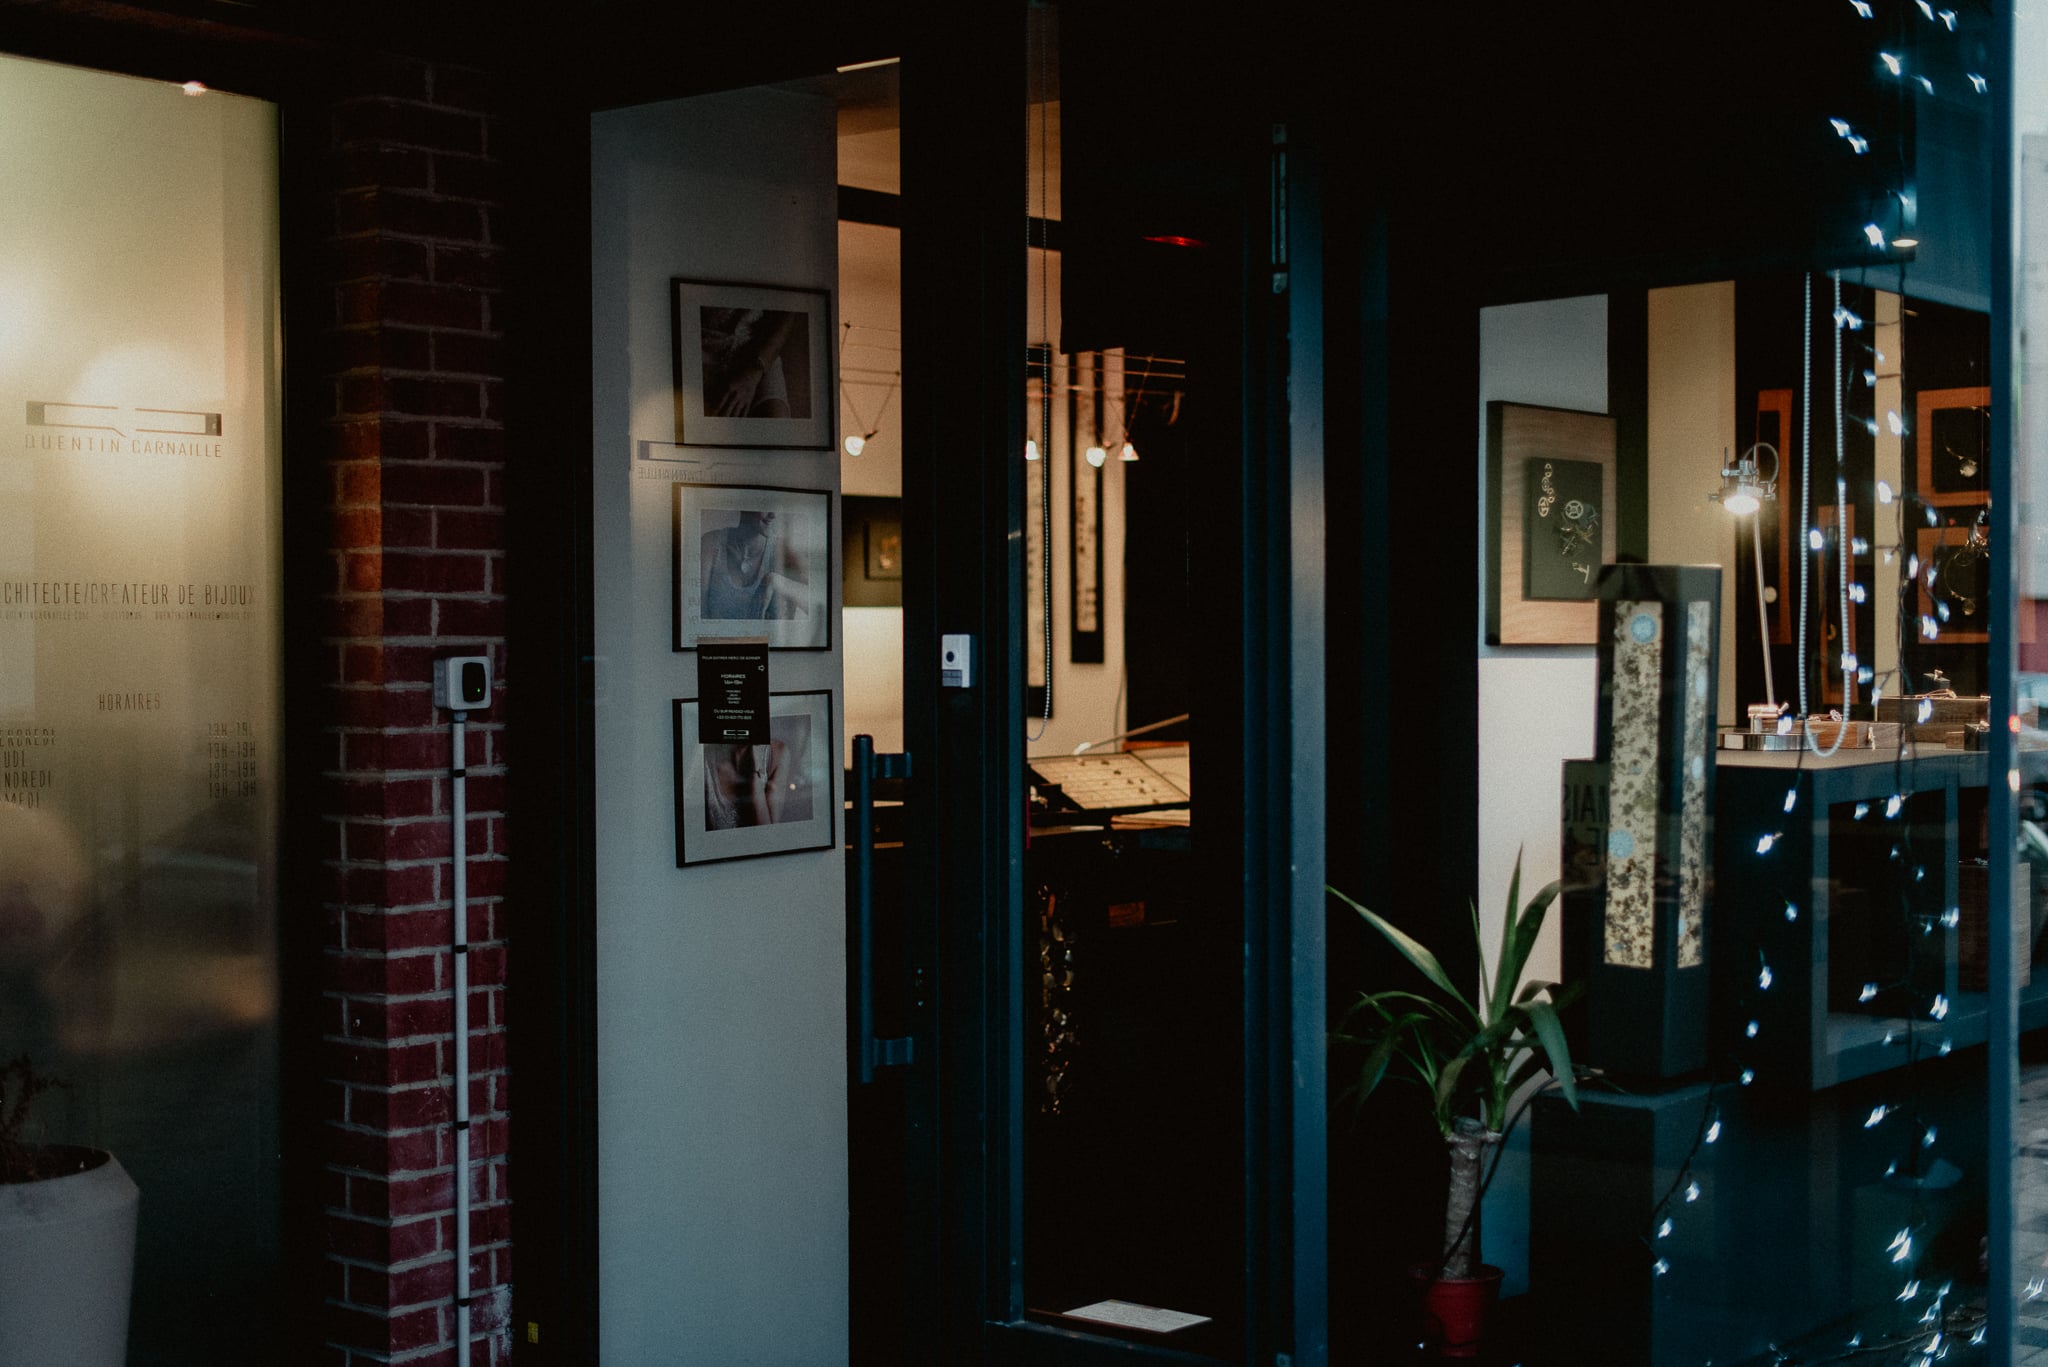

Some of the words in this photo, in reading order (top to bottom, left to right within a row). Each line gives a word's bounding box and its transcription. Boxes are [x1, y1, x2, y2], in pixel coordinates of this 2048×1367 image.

[25, 433, 120, 453] QUENTIN
[132, 439, 222, 458] CARNAILLE
[179, 584, 195, 605] DE
[99, 693, 161, 711] HORAIRES
